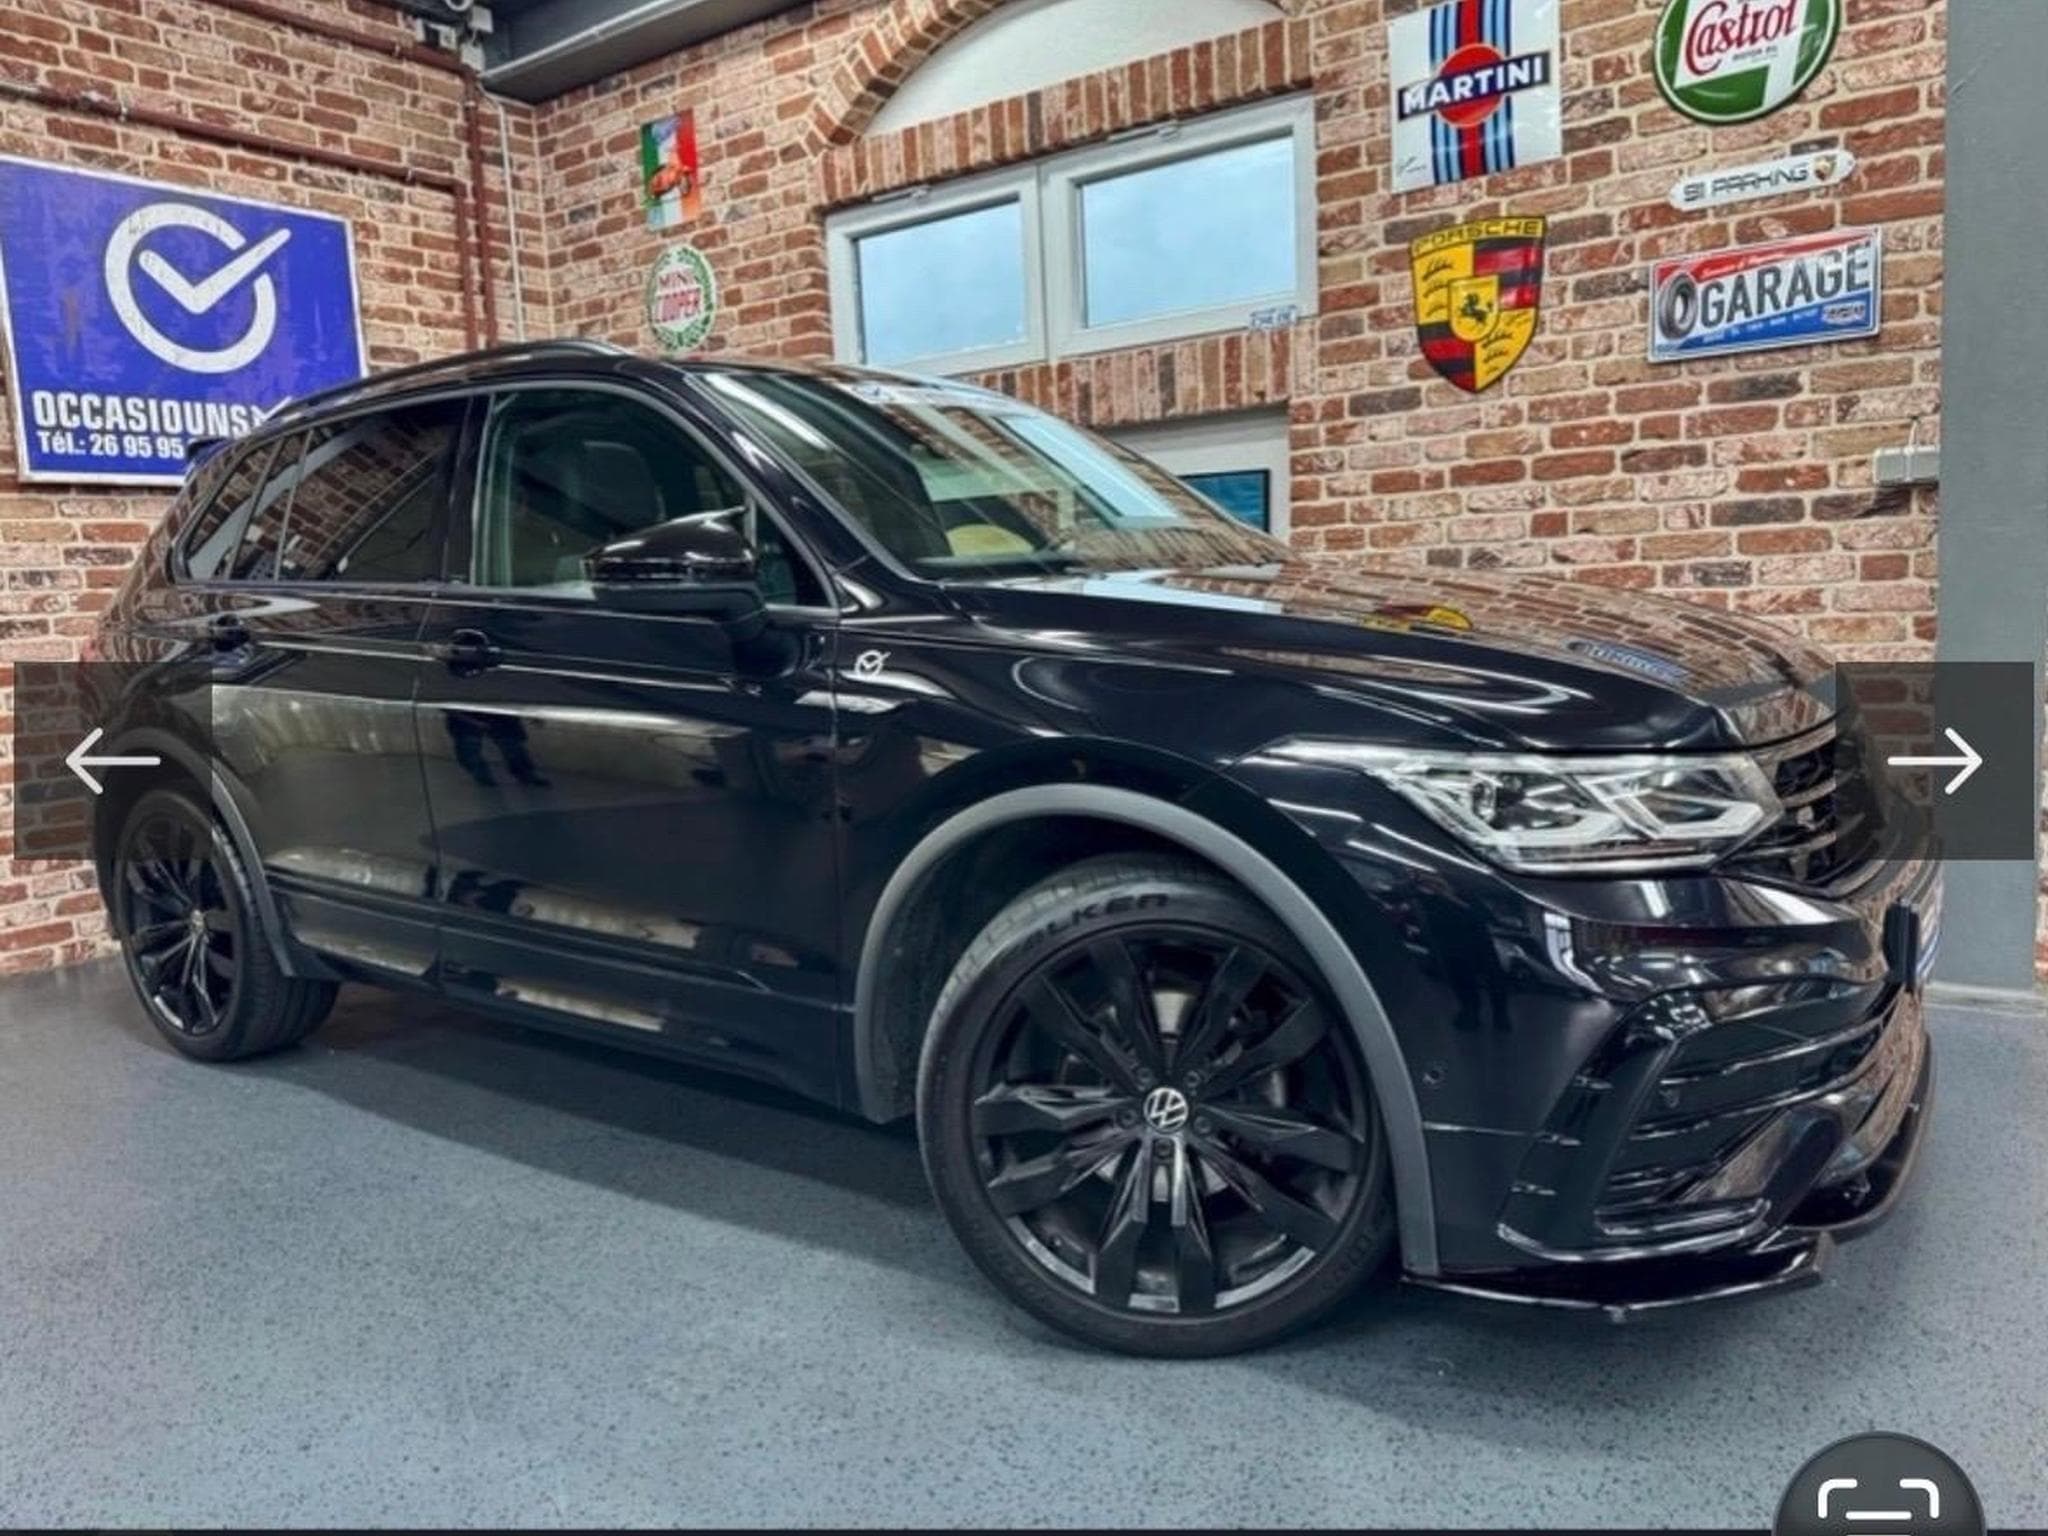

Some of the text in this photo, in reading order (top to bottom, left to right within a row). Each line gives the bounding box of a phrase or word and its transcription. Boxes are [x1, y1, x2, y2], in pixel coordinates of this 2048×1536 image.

[1686, 0, 1797, 76] Castrol
[1402, 57, 1543, 115] MARTINI
[1711, 162, 1810, 195] PARKING
[1415, 219, 1540, 253] PORSCHE
[1700, 239, 1871, 329] GARAGE
[89, 433, 118, 457] 26
[123, 435, 152, 459] 95
[156, 436, 185, 460] 95
